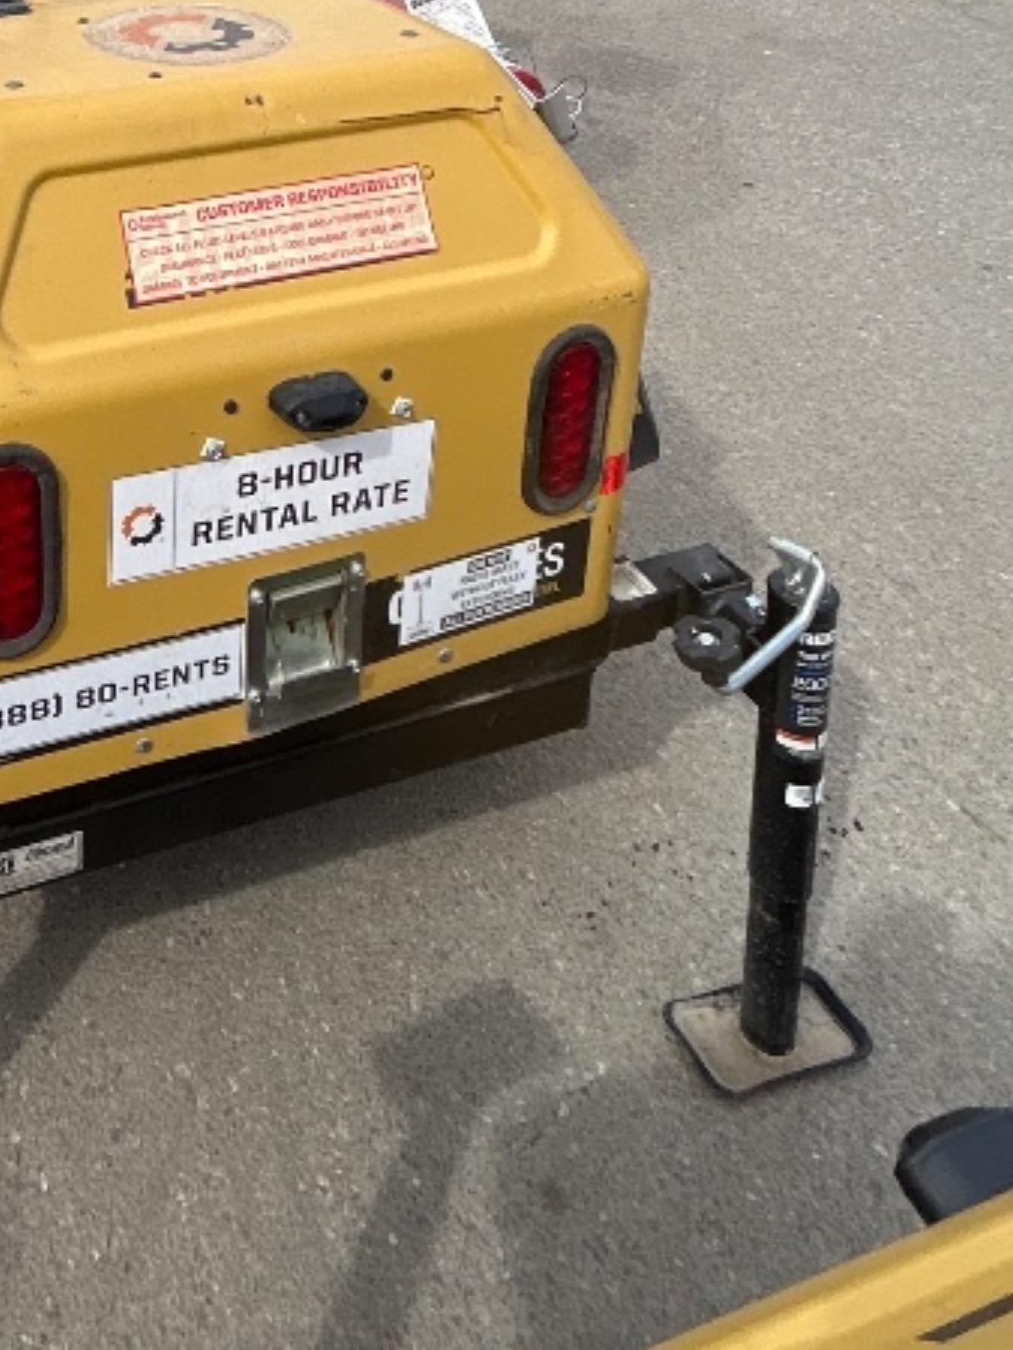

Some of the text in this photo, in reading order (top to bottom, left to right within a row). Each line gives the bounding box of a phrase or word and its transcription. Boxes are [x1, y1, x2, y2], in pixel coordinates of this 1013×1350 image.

[196, 193, 286, 223] CUSTOMER
[287, 171, 418, 210] RESPONSIBILITY
[238, 451, 364, 499] 8-HOUR
[191, 478, 411, 547] RENTAL RATE
[75, 653, 231, 709] 80-RENTS
